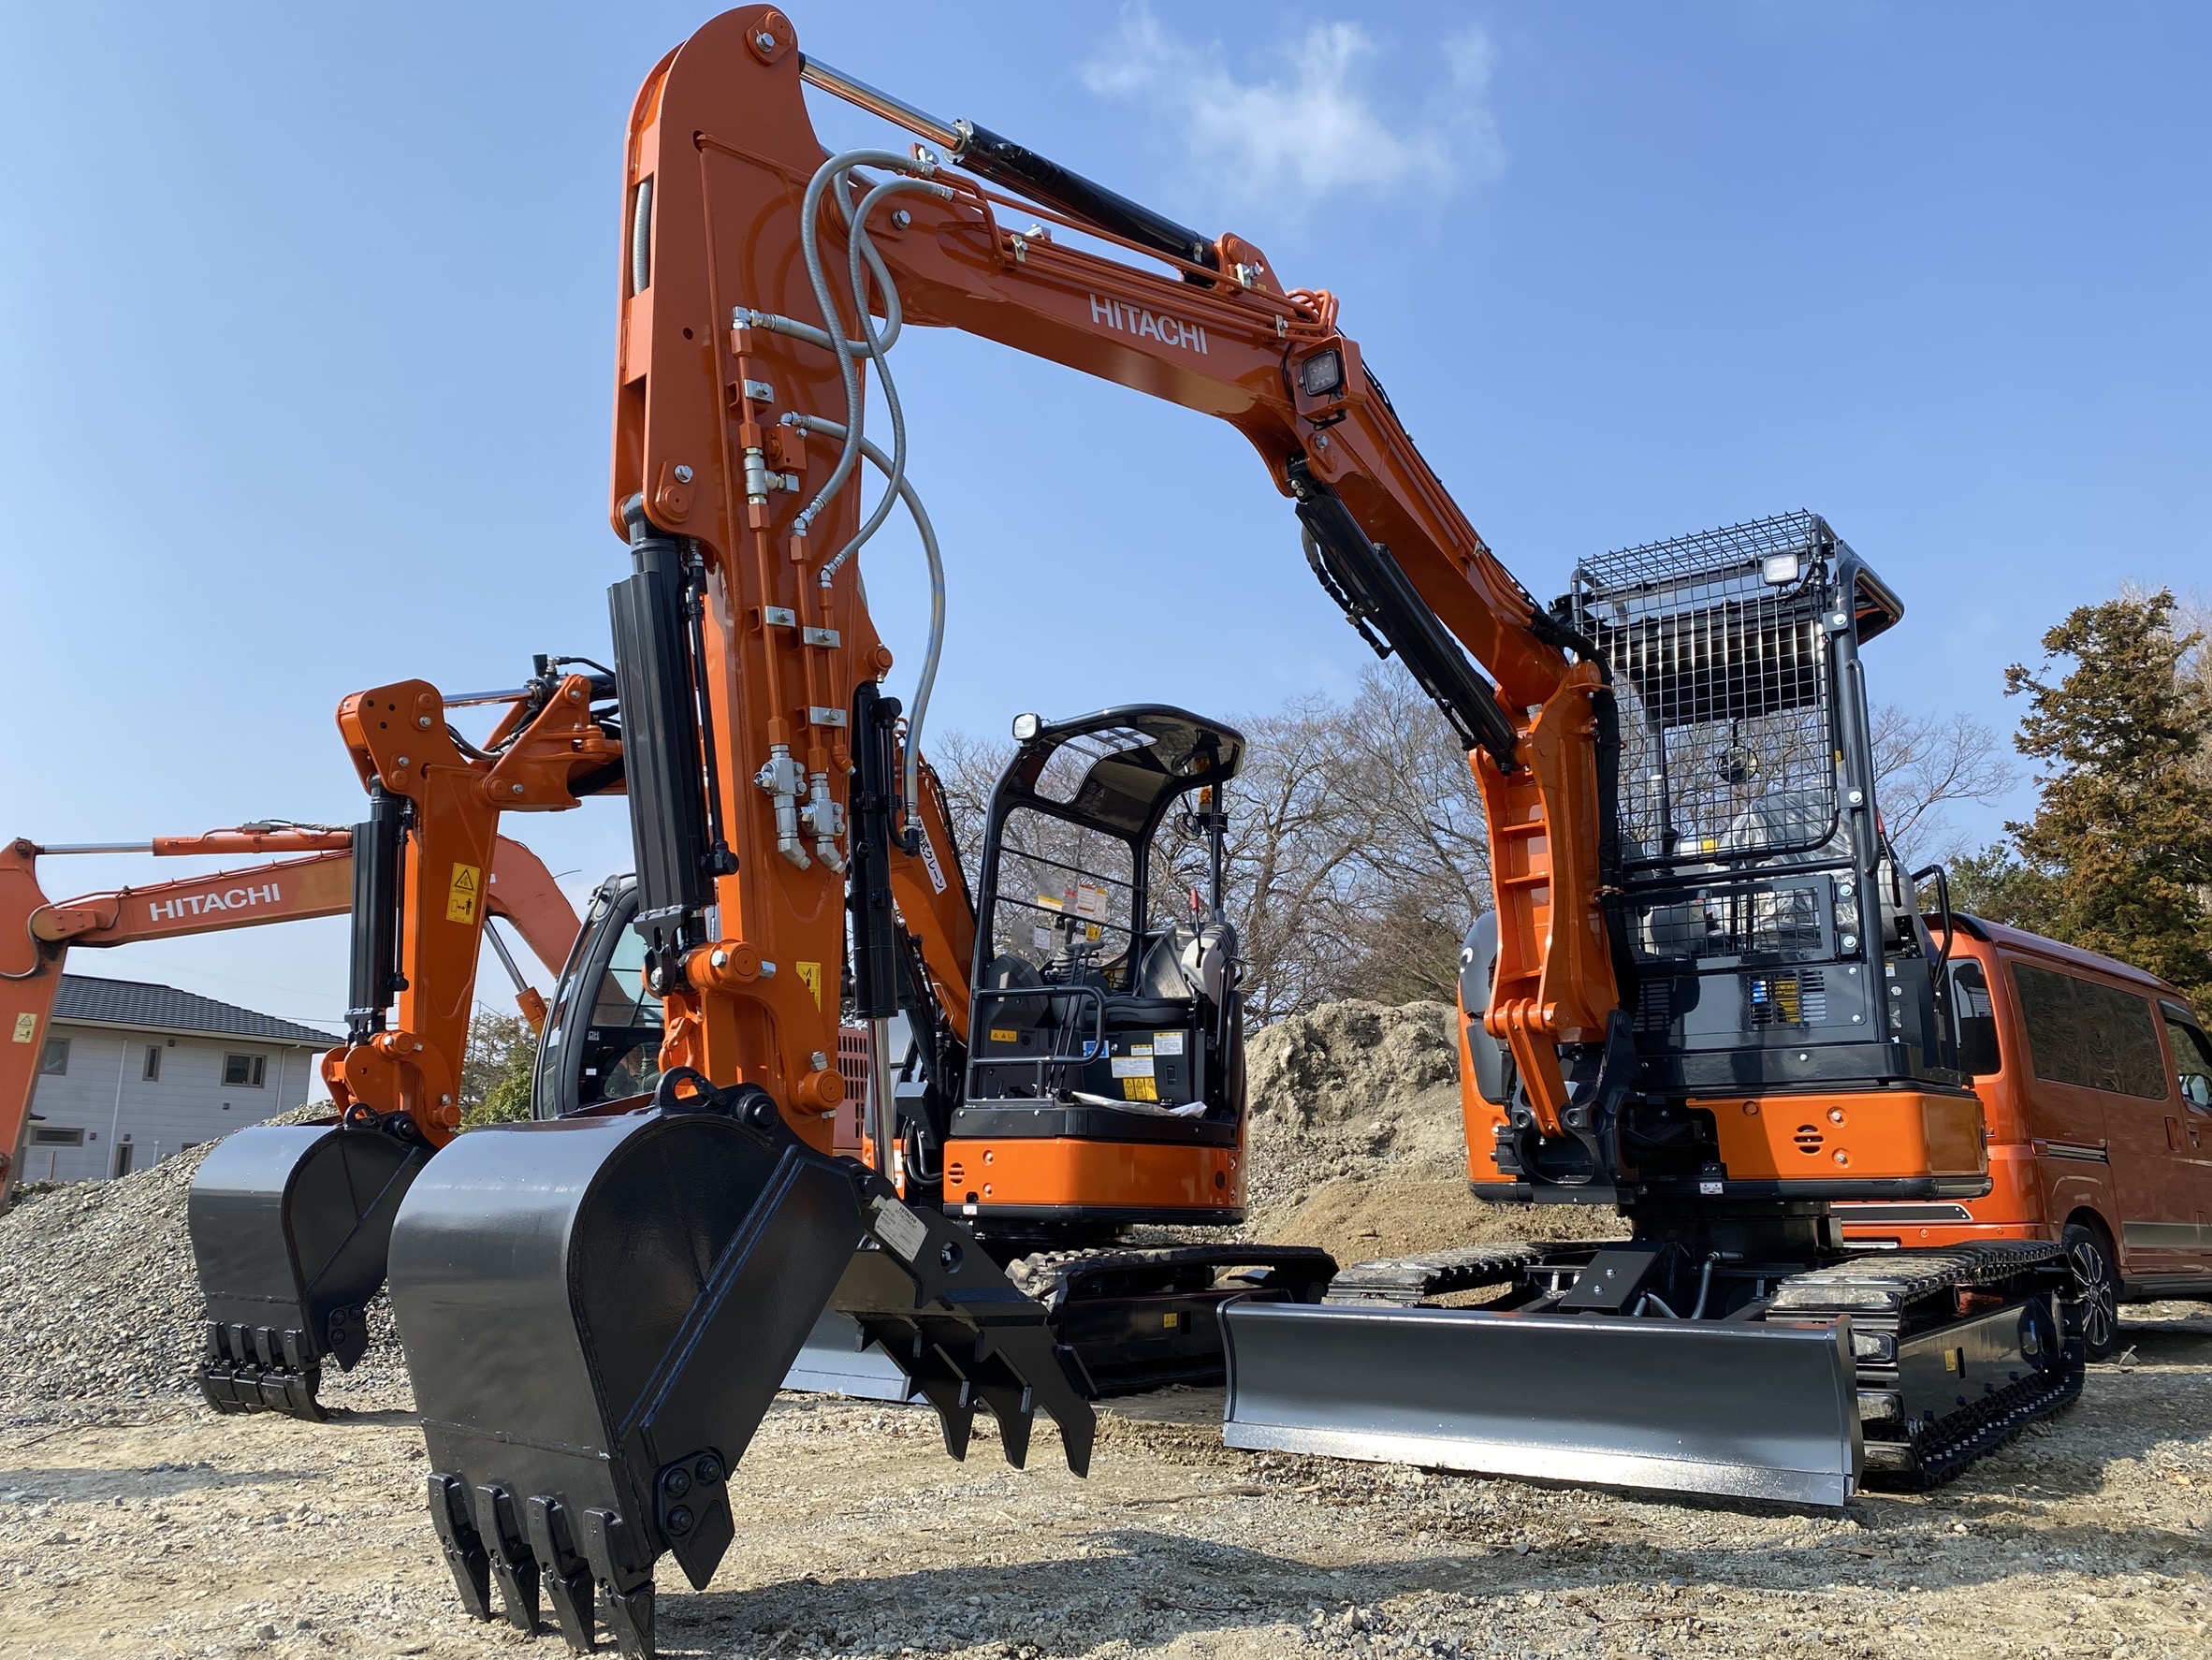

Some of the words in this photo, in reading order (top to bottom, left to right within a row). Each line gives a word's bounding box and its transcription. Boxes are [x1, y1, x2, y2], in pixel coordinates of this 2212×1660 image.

[1089, 293, 1208, 355] HITACHI
[149, 883, 281, 922] HITACHI
[898, 1206, 917, 1225] HITACHI
